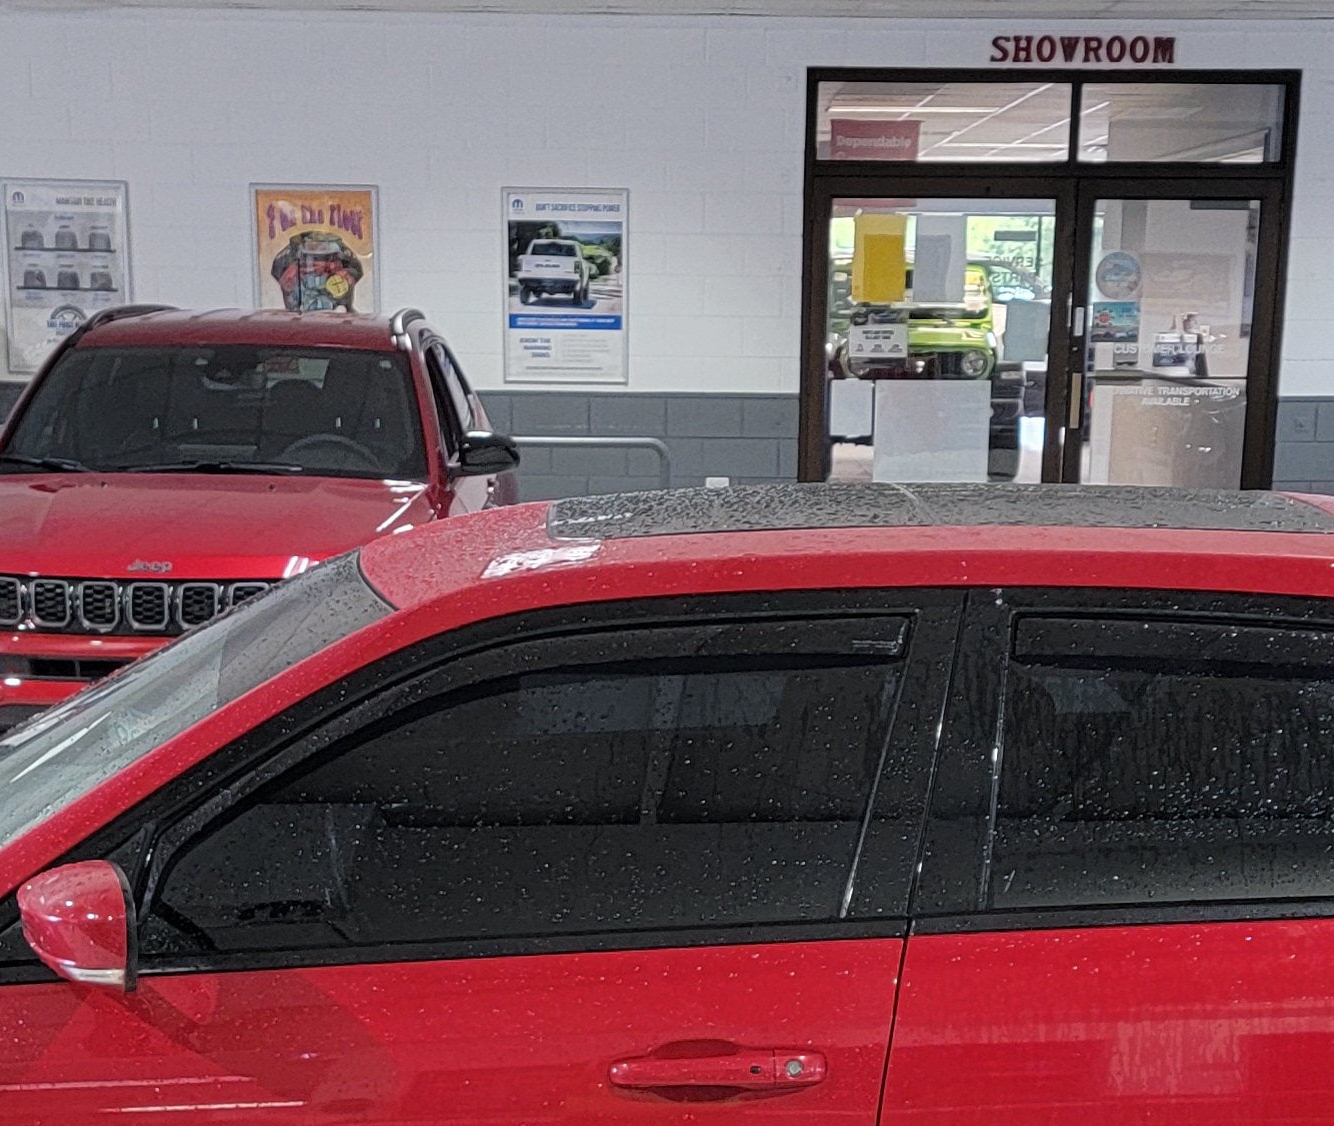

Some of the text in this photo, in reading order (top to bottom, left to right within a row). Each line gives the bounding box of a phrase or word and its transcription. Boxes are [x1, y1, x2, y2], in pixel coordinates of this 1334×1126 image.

[990, 35, 1176, 63] SHOWROOM
[836, 136, 912, 149] Dependable
[1114, 344, 1177, 354] CUSTMER
[1157, 386, 1240, 397] TRANSPORTATION
[1141, 397, 1191, 406] AVAILABLE
[127, 559, 173, 573] Jeep
